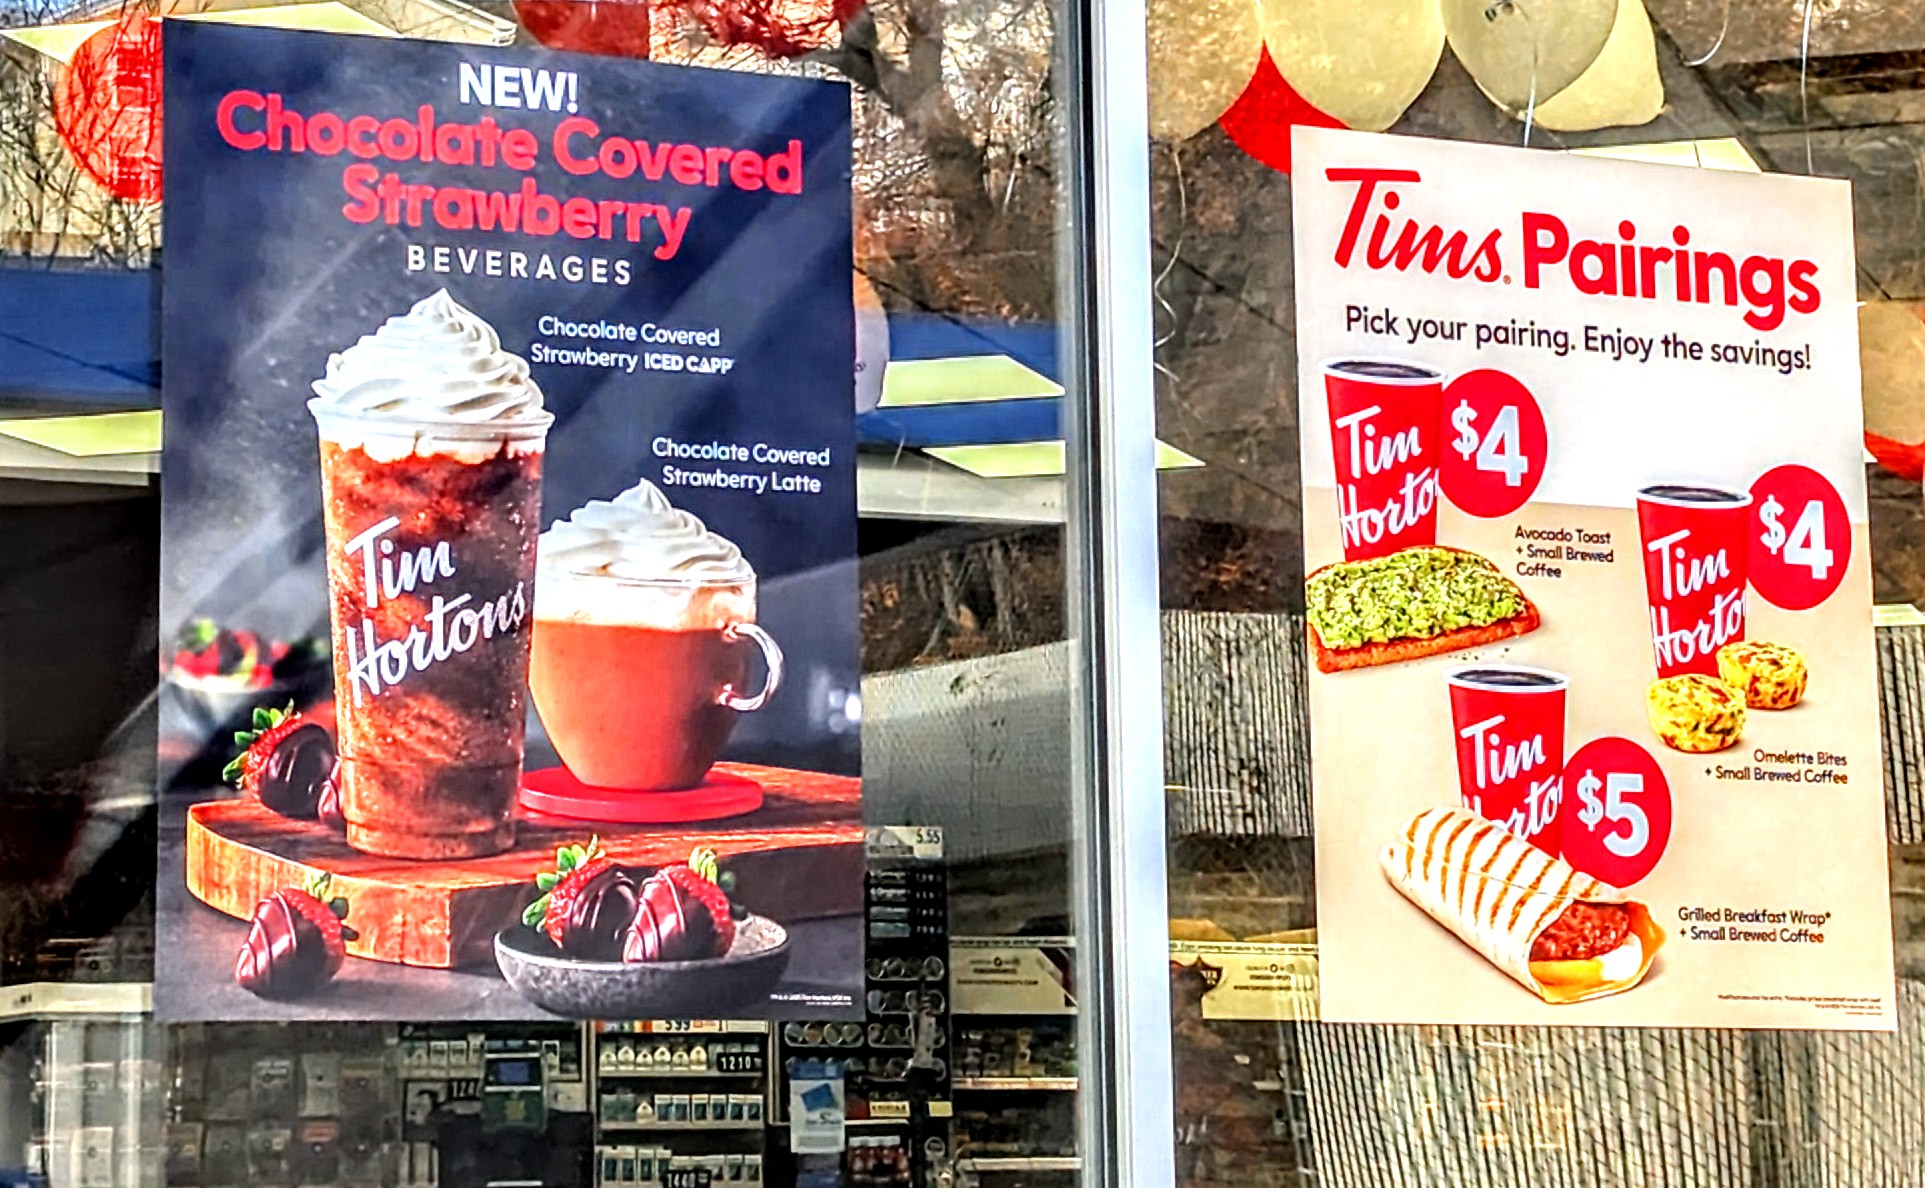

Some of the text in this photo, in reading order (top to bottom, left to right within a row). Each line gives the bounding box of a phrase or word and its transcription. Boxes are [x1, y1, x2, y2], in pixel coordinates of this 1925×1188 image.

[458, 61, 579, 114] NEW!
[216, 89, 803, 195] Chocolate Covered
[342, 163, 691, 261] Strawberry
[406, 244, 633, 286] BEVERAGES
[1324, 167, 1822, 332] Tims Pairings
[530, 343, 639, 373] Strawberry
[644, 353, 684, 371] ICED
[538, 315, 721, 347] Chocolate Covered
[1345, 305, 1813, 374] Pick your pairing. Enjoy the savings!
[652, 436, 831, 466] Chocolate Covered
[1335, 405, 1423, 480] Tim
[1451, 399, 1528, 487] $4
[662, 465, 822, 494] Strawberry Latte
[1337, 466, 1440, 549] Horto
[344, 516, 456, 608] Tim
[1515, 526, 1612, 545] Avocado Toast
[1516, 562, 1562, 578] Coffee
[1527, 545, 1562, 559] Small
[1566, 548, 1614, 563] Brewed
[1647, 529, 1730, 601] Tim
[1759, 494, 1834, 580] $4
[345, 581, 525, 708] Hortons
[1650, 587, 1746, 669] Horto
[1460, 714, 1546, 789] Tim
[1716, 765, 1750, 780] Small
[1754, 768, 1800, 782] Brewed
[1804, 769, 1848, 784] Coffee
[1754, 748, 1847, 766] Omelette Bites
[1577, 769, 1650, 857] $5
[1678, 906, 1720, 922] Grilled
[1724, 908, 1787, 923] Breakfast
[1690, 926, 1725, 941] Small
[1729, 927, 1777, 942] Brewed
[1780, 928, 1824, 943] Coffee
